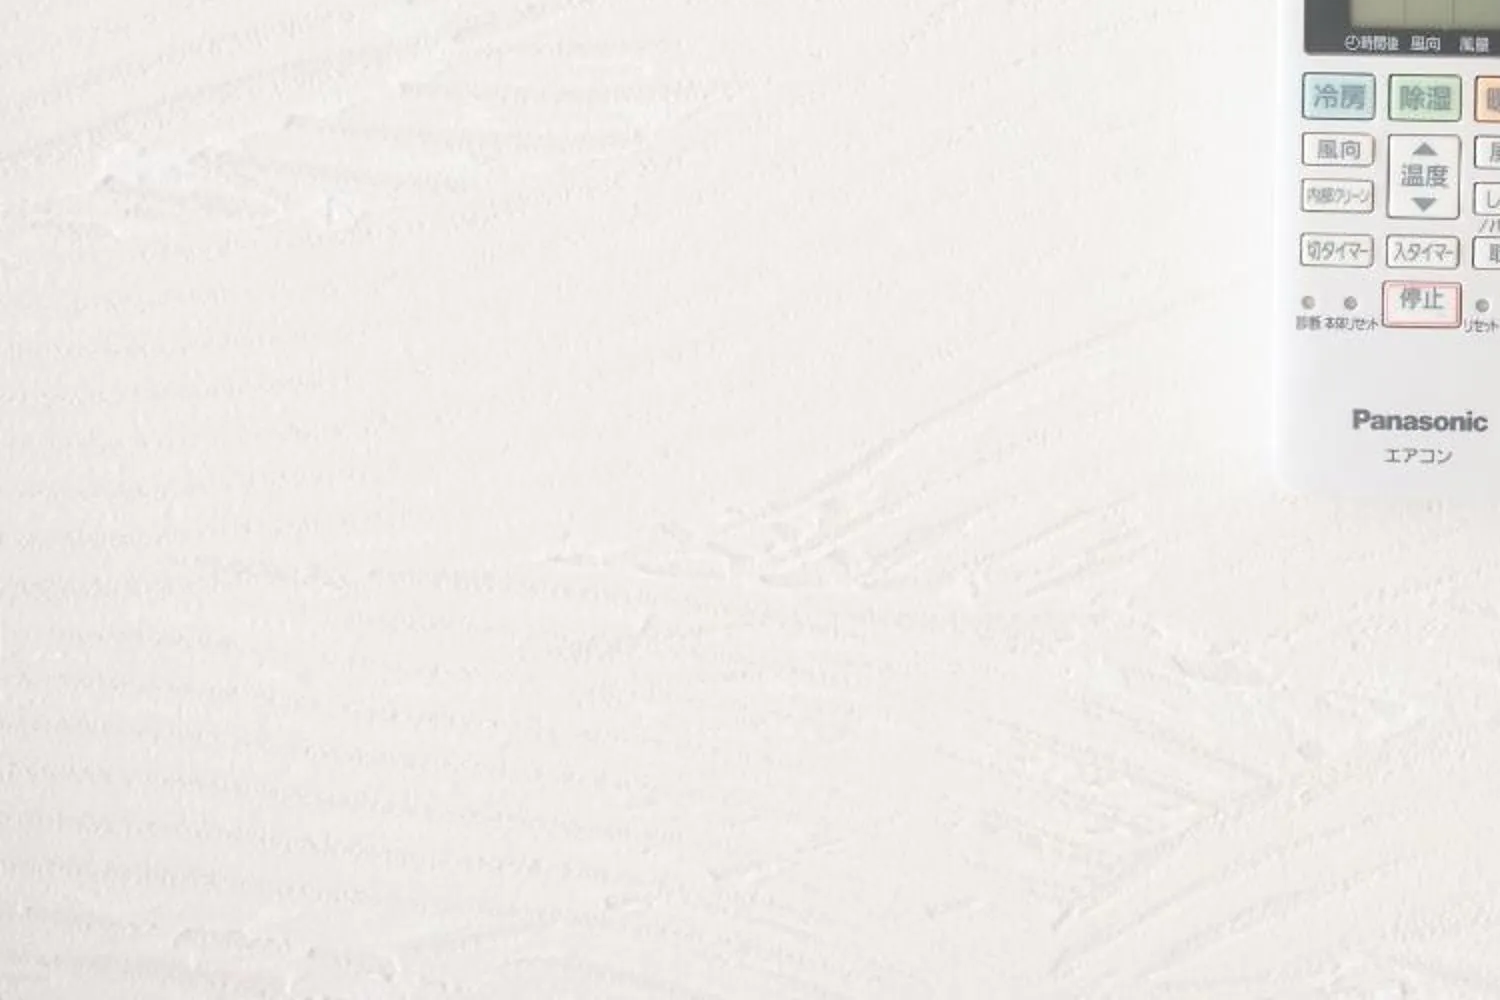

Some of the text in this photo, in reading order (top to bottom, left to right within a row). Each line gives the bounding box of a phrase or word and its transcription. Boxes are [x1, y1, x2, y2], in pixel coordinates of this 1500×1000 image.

[1411, 36, 1441, 51] 風向
[1314, 84, 1365, 111] 冷房
[1400, 85, 1453, 111] 除湿
[1317, 139, 1361, 160] 風向
[1401, 164, 1449, 188] 温度
[1307, 187, 1370, 205] 内部クリーン
[1307, 241, 1368, 261] 切タイマー
[1394, 243, 1453, 262] 入タイマー
[1400, 287, 1444, 310] 停止
[1464, 318, 1499, 333] リセット
[1352, 408, 1488, 432] Panasonic
[1384, 448, 1453, 464] エアコン
